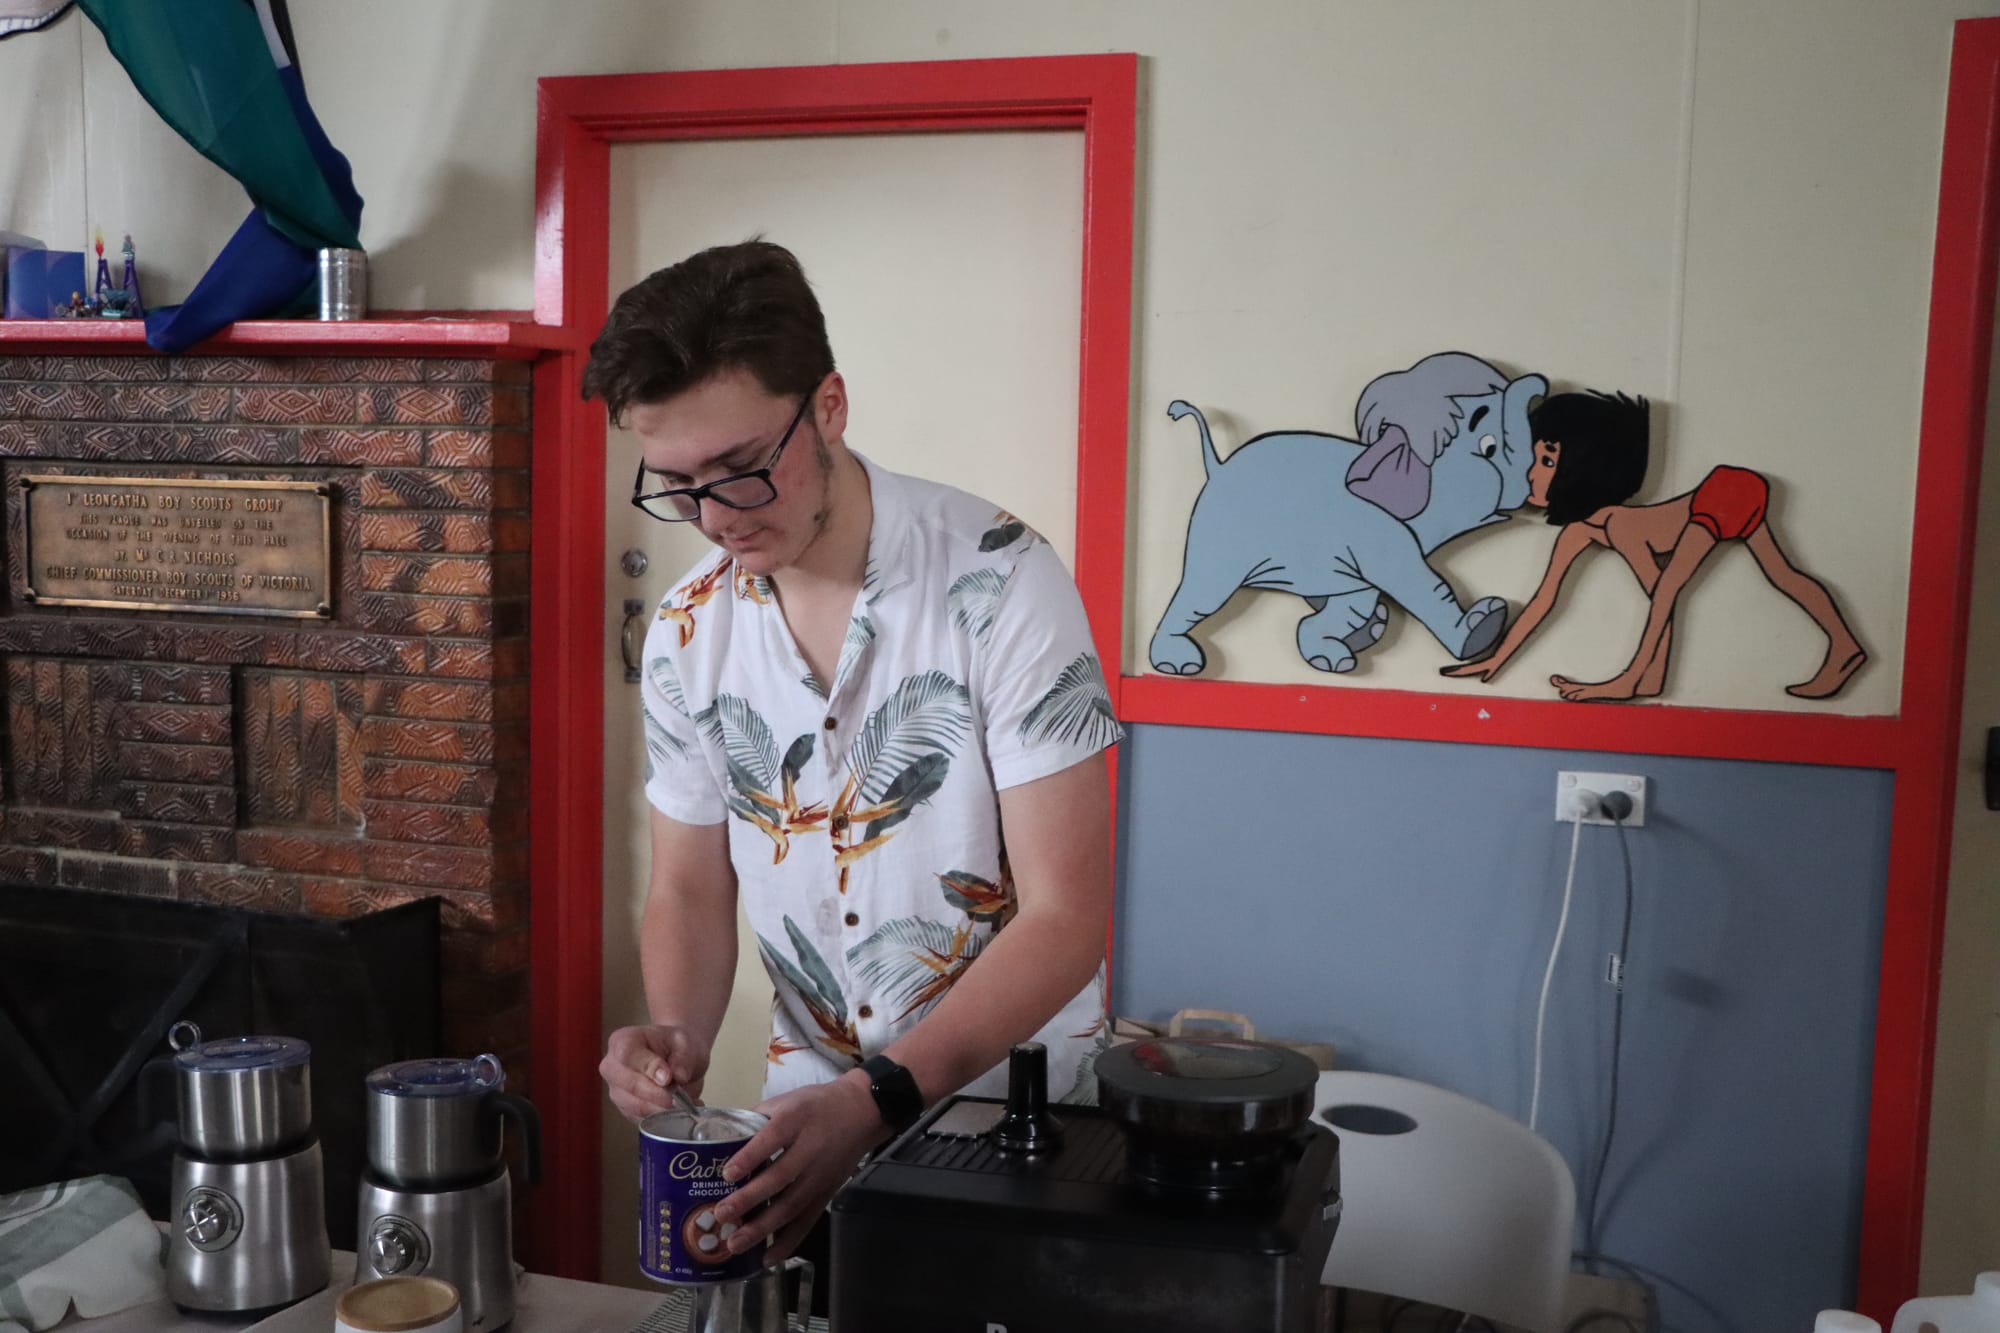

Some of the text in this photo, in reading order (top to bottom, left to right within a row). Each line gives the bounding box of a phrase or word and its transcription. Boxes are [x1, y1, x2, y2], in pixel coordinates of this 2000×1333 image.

[83, 493, 148, 508] LEONGATHA
[159, 495, 181, 510] BOY
[191, 496, 232, 511] SCOUTS
[245, 498, 283, 513] GROUP
[254, 519, 273, 531] THE
[136, 531, 152, 543] THE
[210, 533, 221, 545] OF
[264, 535, 288, 548] HALL
[184, 552, 236, 568] NICHOLS
[47, 566, 312, 592] CHIEF COMMISSIONER BOY SCOUTS OF VICTORIA
